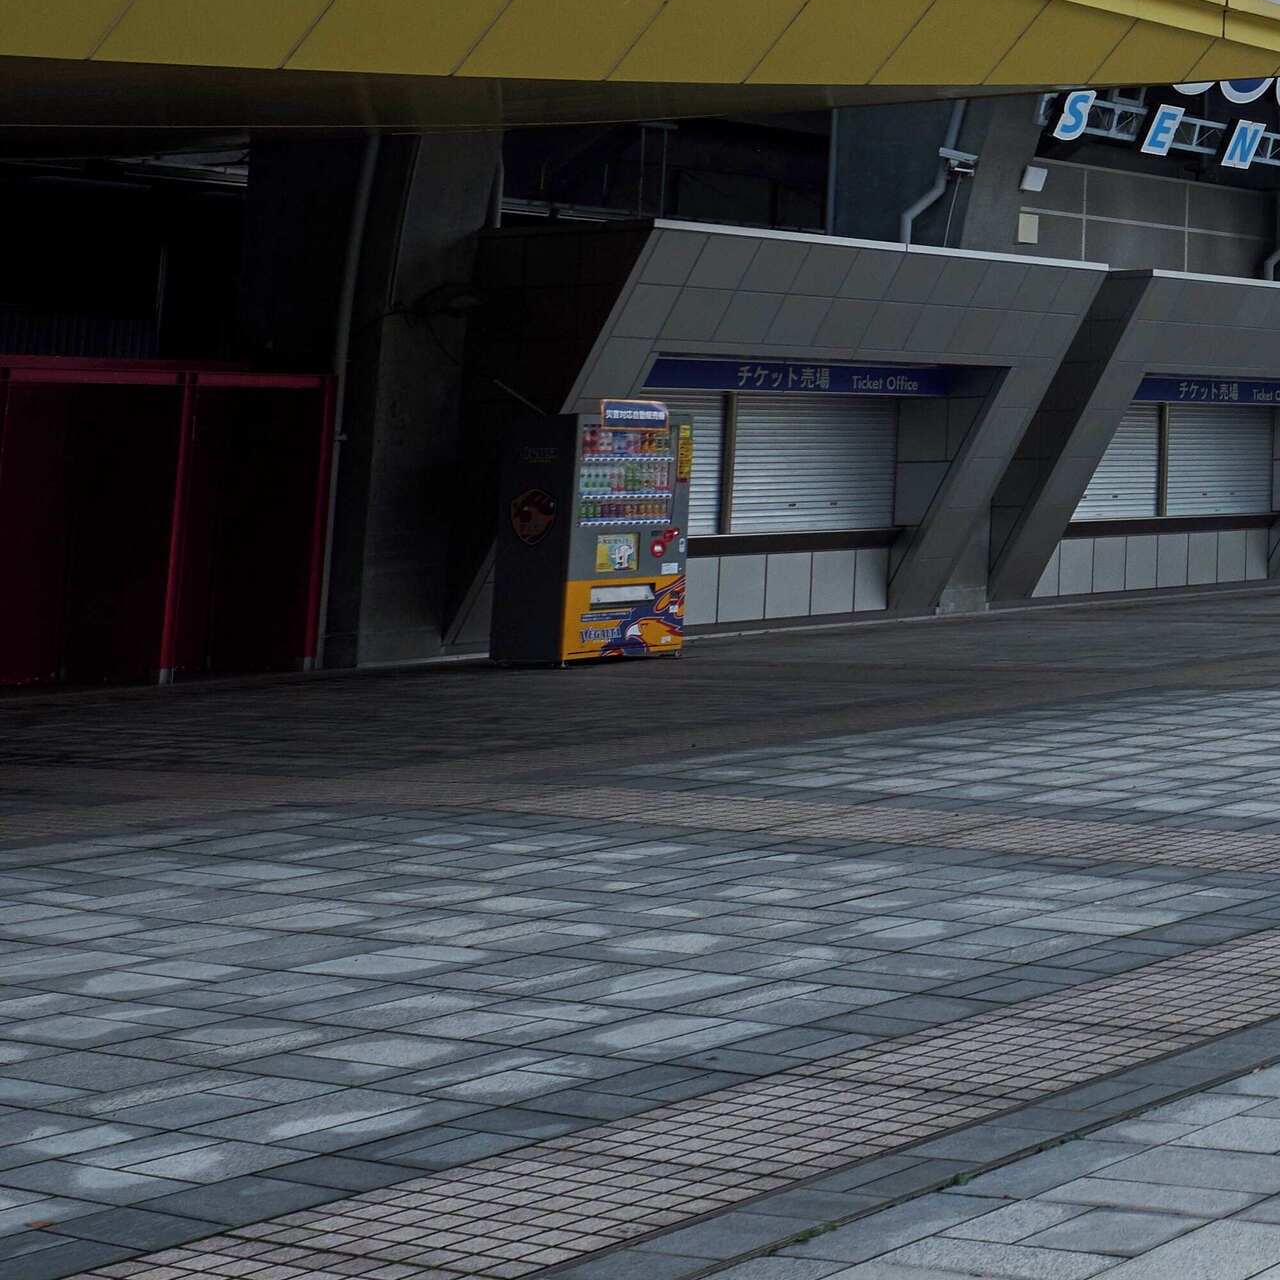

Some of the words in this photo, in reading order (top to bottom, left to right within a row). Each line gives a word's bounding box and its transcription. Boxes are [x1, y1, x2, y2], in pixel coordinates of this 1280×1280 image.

[737, 366, 831, 390] チケット売場
[851, 374, 884, 390] Ticket
[886, 375, 919, 391] Office
[1179, 381, 1239, 401] チケット売場
[1252, 388, 1274, 401] Ticket
